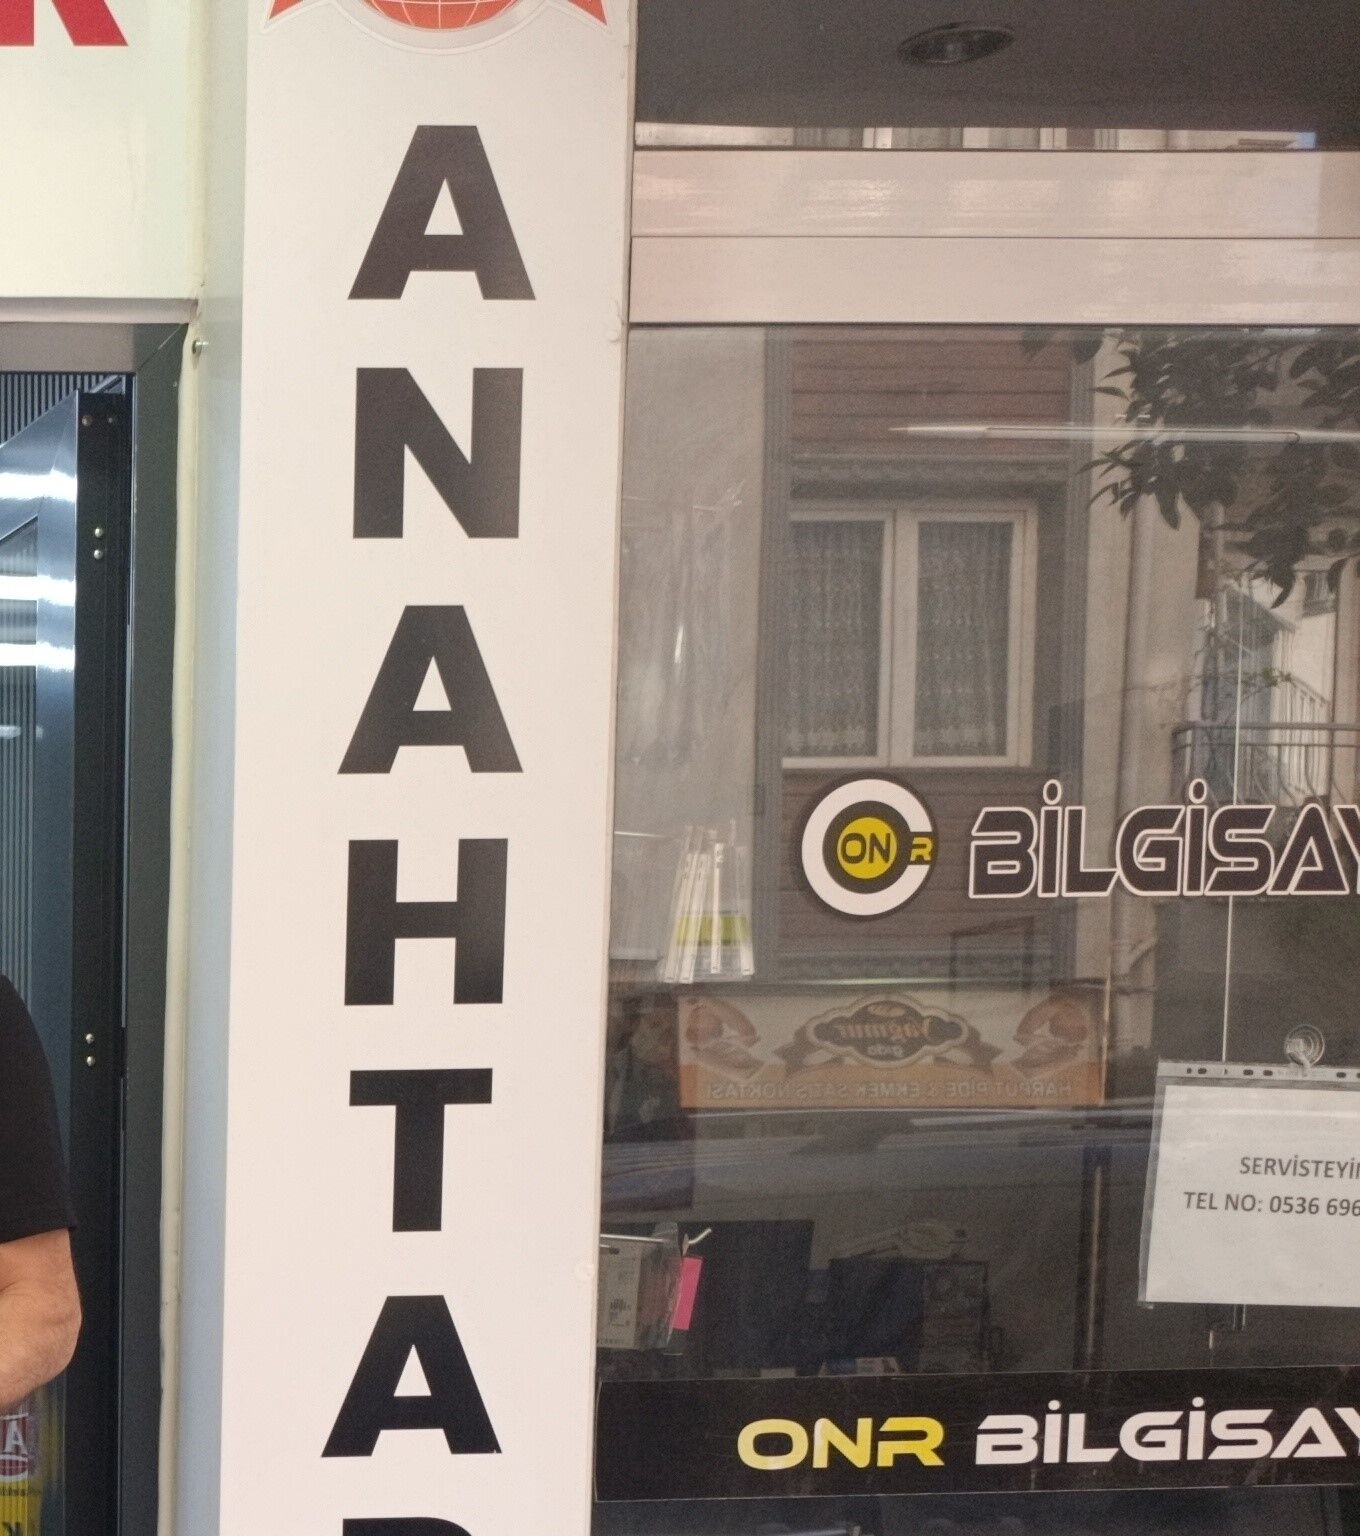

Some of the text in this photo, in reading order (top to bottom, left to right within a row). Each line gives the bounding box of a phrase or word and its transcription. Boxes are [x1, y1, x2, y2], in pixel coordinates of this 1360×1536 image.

[1183, 1191, 1218, 1211] TEL
[1224, 1193, 1263, 1213] NO:
[1269, 1195, 1320, 1215] 0536
[736, 1415, 945, 1471] ONR
